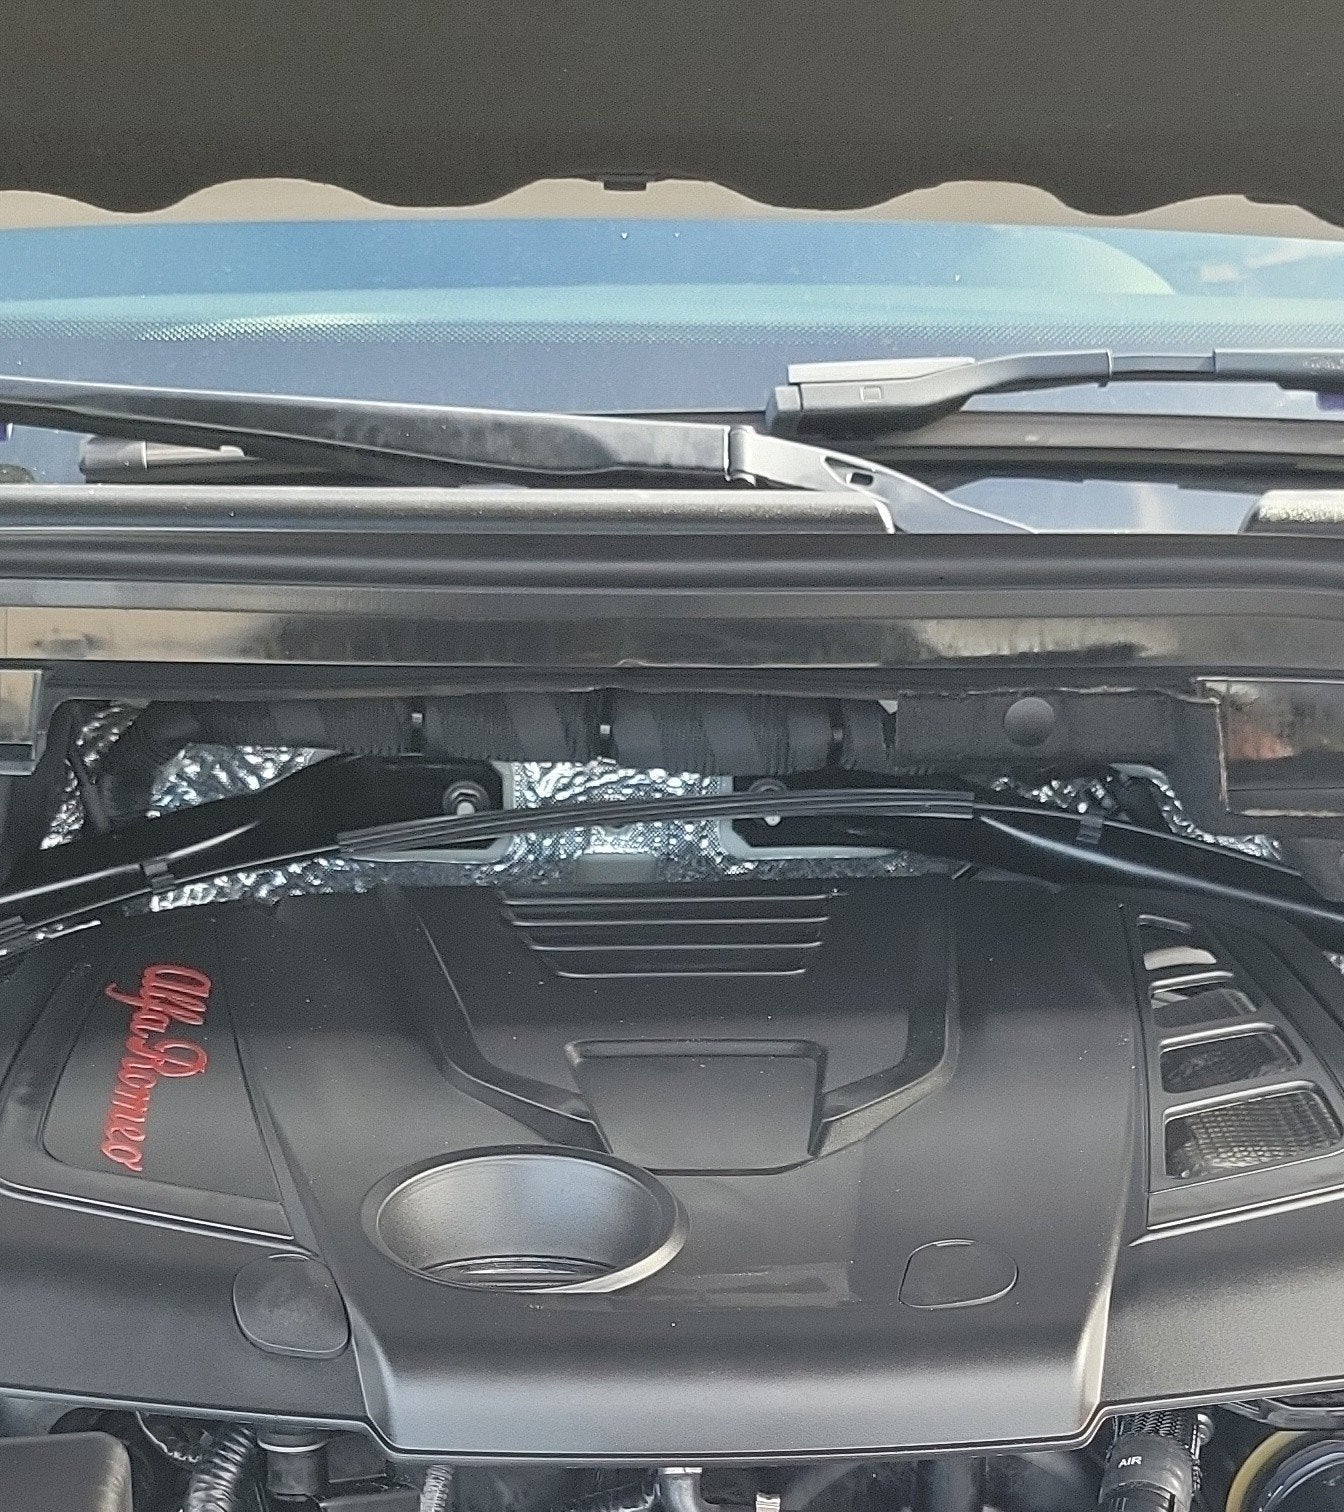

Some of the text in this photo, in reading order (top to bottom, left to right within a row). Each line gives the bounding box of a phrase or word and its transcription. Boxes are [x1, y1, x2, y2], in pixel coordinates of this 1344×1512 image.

[100, 963, 212, 1172] Alfa Romeo
[1117, 1455, 1143, 1469] AIR
